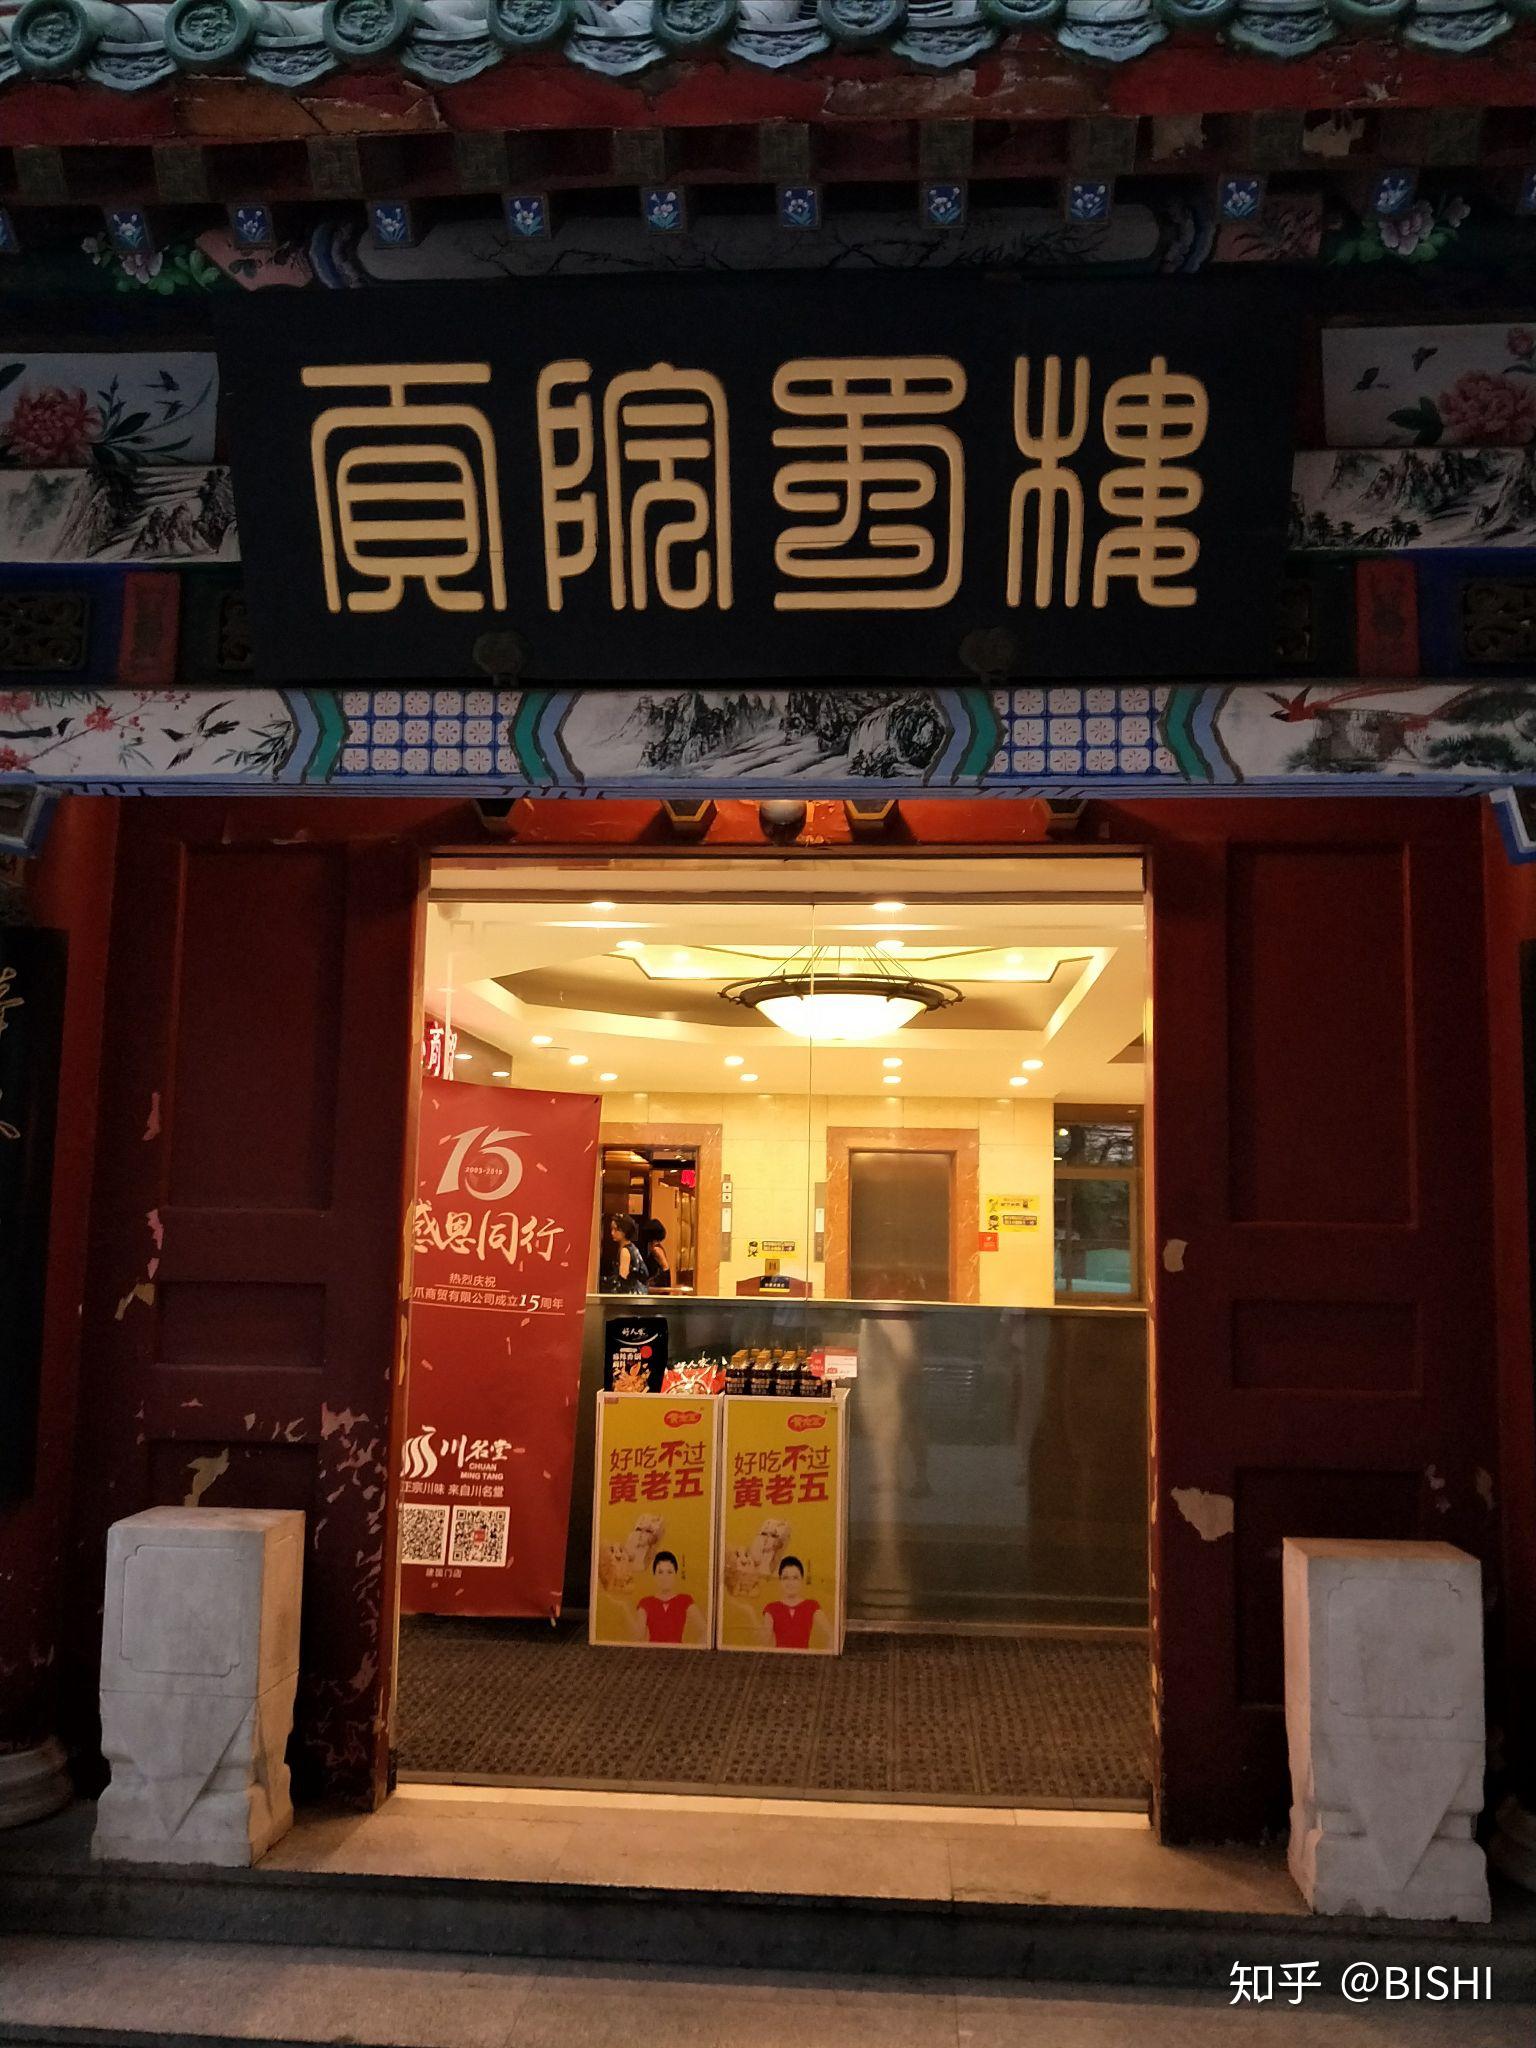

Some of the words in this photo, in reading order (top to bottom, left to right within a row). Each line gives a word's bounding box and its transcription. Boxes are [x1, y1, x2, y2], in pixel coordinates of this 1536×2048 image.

[436, 1125, 532, 1200] 15
[413, 1198, 565, 1265] 感恩同行
[450, 1272, 496, 1288] 热烈庆祝
[622, 1327, 646, 1337] 好人家
[440, 1434, 512, 1468] 川名堂
[469, 1462, 497, 1471] CHUAN
[610, 1440, 706, 1472] 好吃不过
[734, 1444, 831, 1476] 好吃不过
[448, 1484, 504, 1498] 来自川名堂
[460, 1471, 481, 1480] MING
[482, 1472, 504, 1481] TANG
[608, 1467, 704, 1505] 黄老五
[733, 1472, 829, 1509] 黄老五
